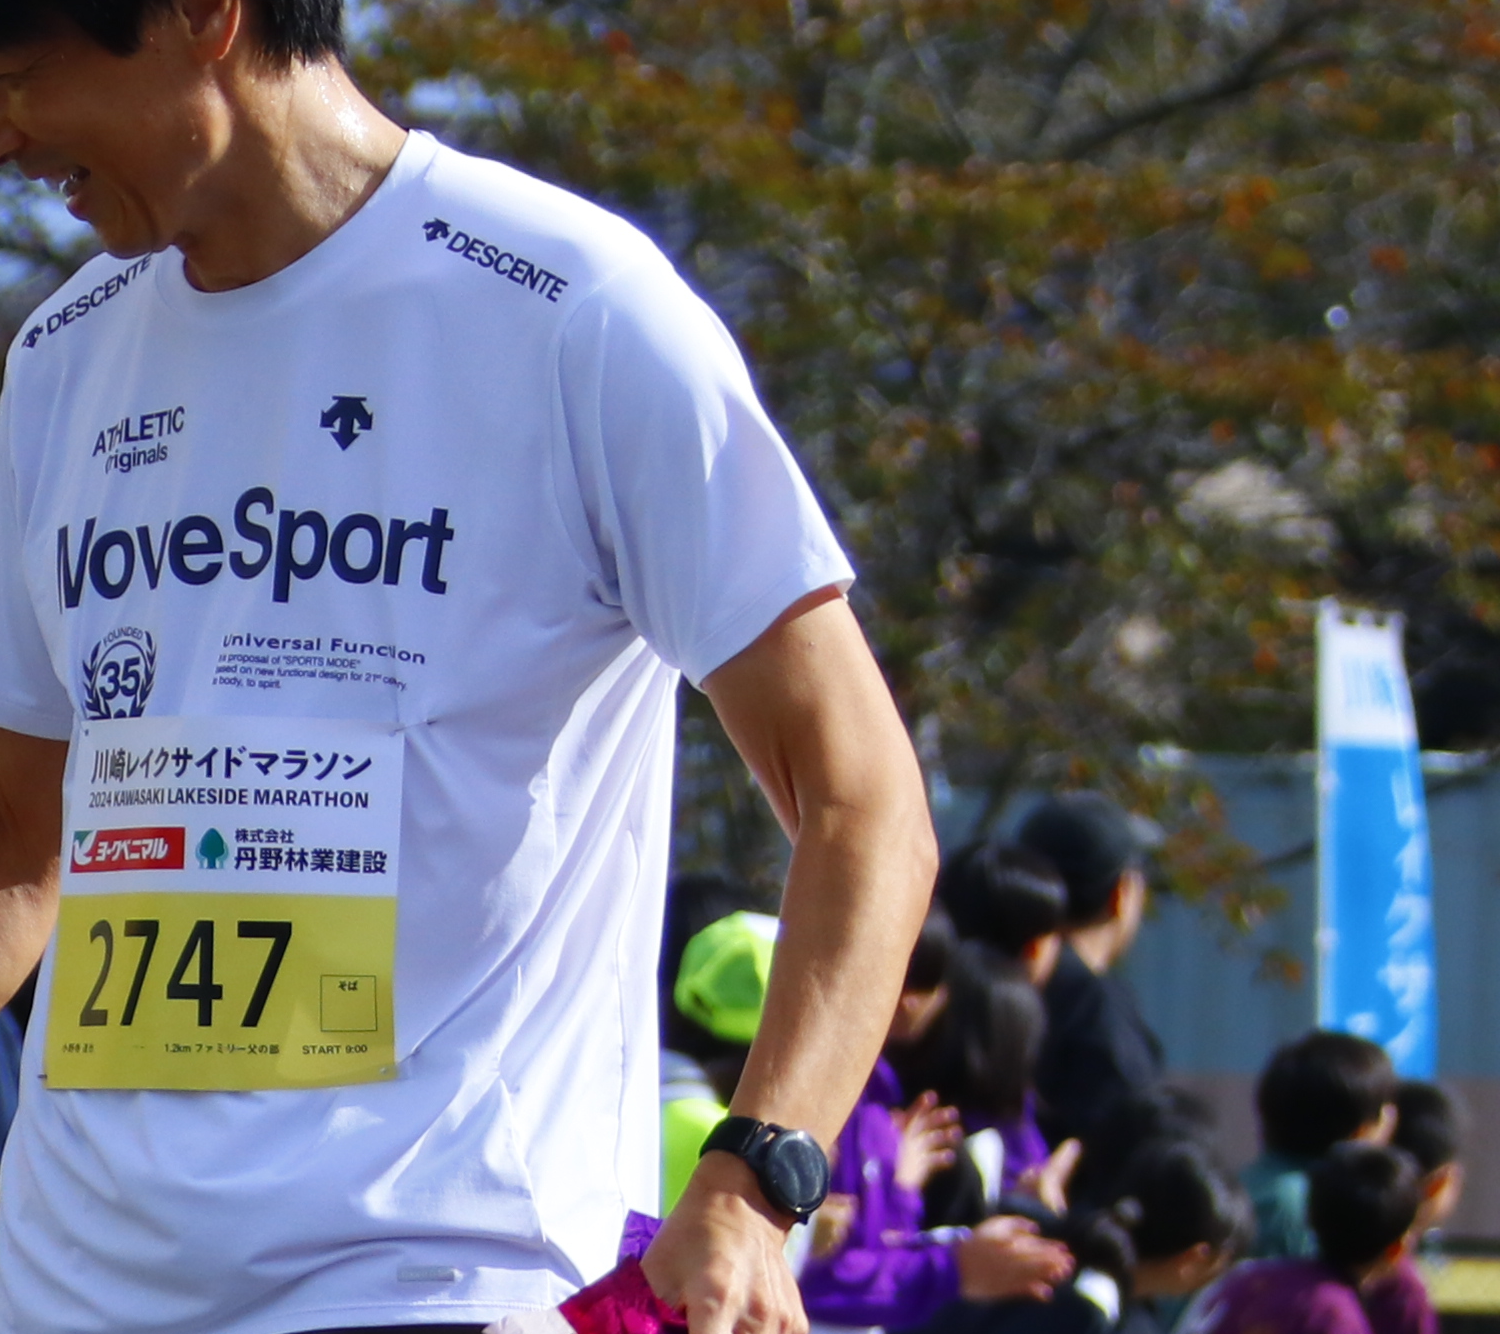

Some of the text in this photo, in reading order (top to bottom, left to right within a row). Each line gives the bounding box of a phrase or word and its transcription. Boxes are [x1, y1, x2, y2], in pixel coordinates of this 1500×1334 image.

[446, 231, 568, 302] DESCENTE
[47, 252, 152, 335] DESCENTE
[92, 406, 184, 457] ATHLETIC
[103, 626, 144, 647] FOUNDED
[223, 633, 322, 652] Universal
[227, 653, 269, 666] proposal
[271, 655, 280, 665] of
[99, 657, 140, 699] 35
[239, 666, 252, 674] on
[254, 667, 274, 676] new
[277, 667, 317, 678] functional
[318, 670, 348, 682] design
[350, 671, 362, 681] for
[91, 745, 372, 784] 川崎レイクサイドマラソン
[89, 788, 369, 809] 2024 KAWASAKI LAKESIDE MARATHON
[235, 828, 294, 843] 株式会社
[96, 837, 168, 861] ヨークベニマル
[234, 848, 387, 874] 丹野林業建設
[79, 918, 292, 1028] 2747
[164, 1043, 191, 1054] 1.2km
[302, 1044, 368, 1055] START 9:00
